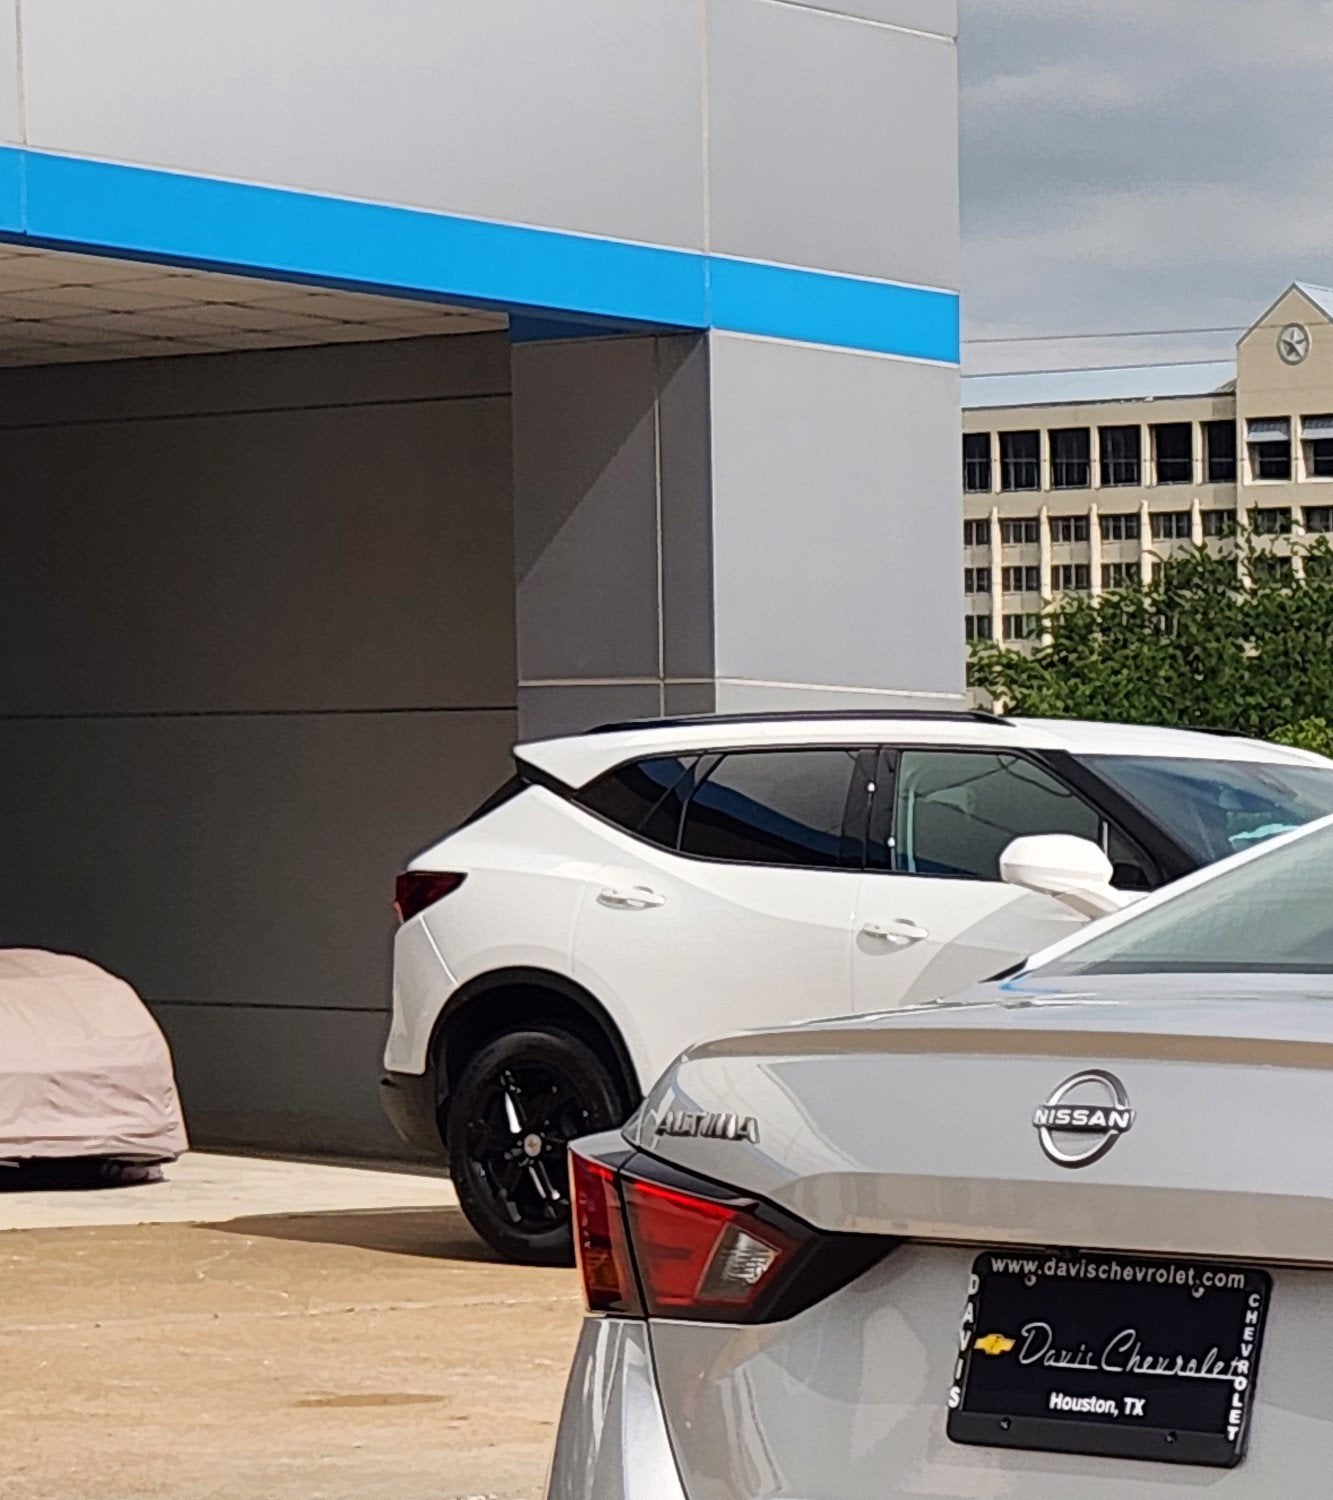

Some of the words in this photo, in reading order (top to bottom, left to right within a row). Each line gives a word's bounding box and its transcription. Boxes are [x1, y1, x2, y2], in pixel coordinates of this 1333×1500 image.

[655, 1110, 760, 1144] ALTIMA
[1033, 1108, 1130, 1128] NISSAN
[991, 1256, 1245, 1289] www.davischevrolet.com
[948, 1273, 980, 1409] DAVIS
[1018, 1321, 1098, 1370] Davis
[1100, 1328, 1241, 1380] Chevrolet
[1227, 1293, 1260, 1441] CHEVROLET
[1049, 1391, 1119, 1418] Houston,
[1123, 1396, 1146, 1416] TX
